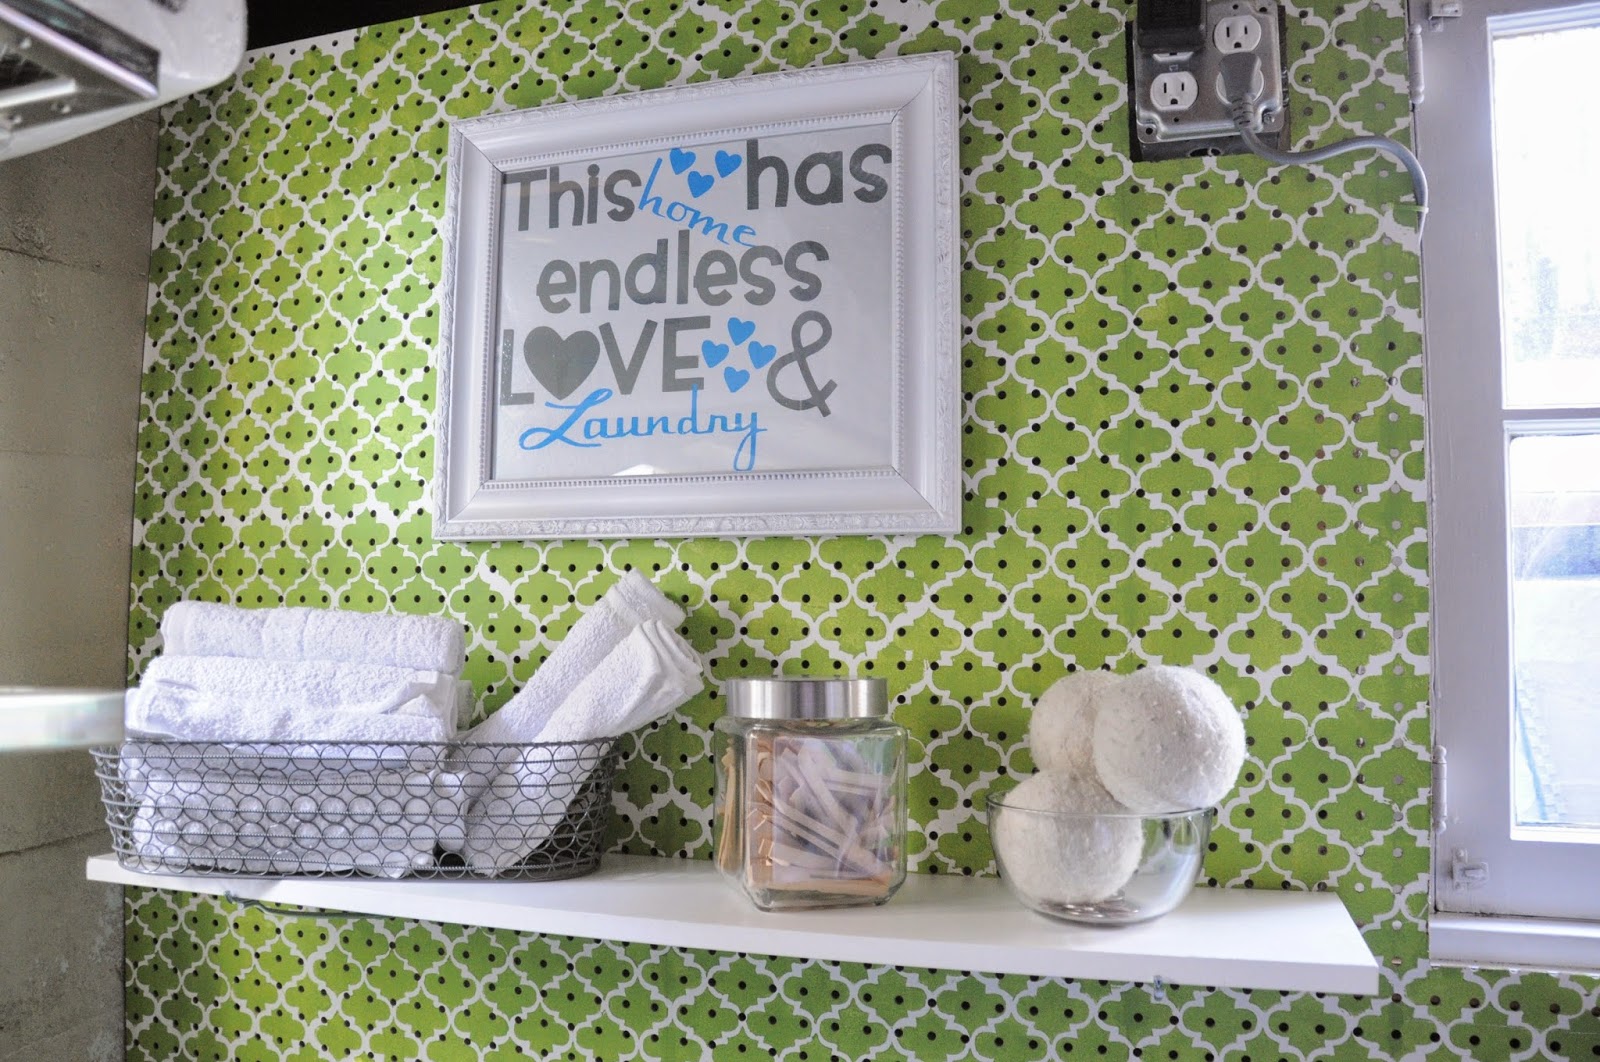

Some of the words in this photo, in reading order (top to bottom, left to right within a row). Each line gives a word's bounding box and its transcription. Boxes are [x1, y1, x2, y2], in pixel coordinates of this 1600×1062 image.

[504, 163, 642, 231] This
[638, 158, 757, 248] home
[746, 139, 892, 210] has
[536, 229, 830, 314] endless
[766, 310, 838, 417] &
[518, 384, 767, 471] Laundry
